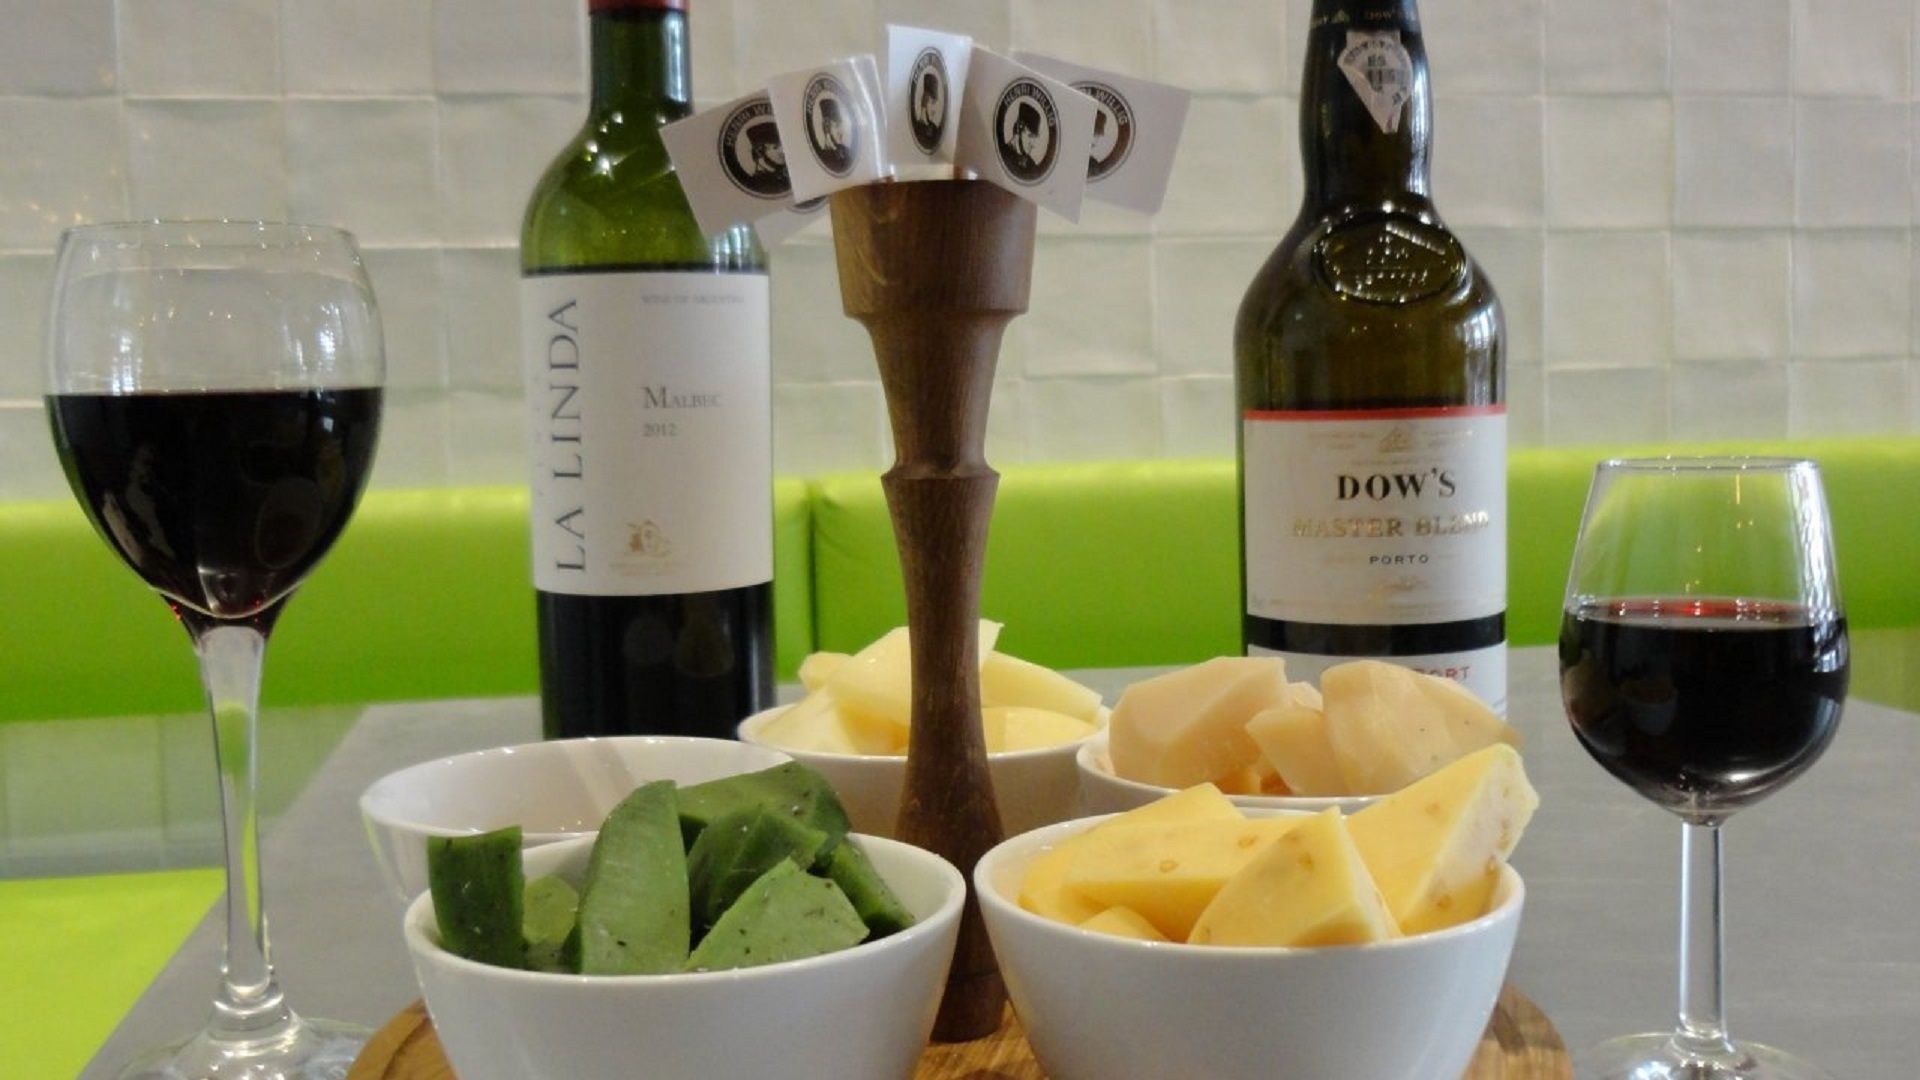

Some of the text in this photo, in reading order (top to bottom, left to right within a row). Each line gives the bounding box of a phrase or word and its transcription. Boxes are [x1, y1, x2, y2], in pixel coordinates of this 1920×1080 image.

[1004, 84, 1030, 106] HENRI
[1032, 86, 1056, 127] WILLIG
[1096, 87, 1128, 125] WILLIG
[725, 109, 752, 147] HENRI
[548, 299, 586, 572] LA LINDA
[643, 423, 678, 437] 2012
[1335, 467, 1457, 500] DOW'S
[1292, 517, 1404, 538] MASTER
[1368, 554, 1430, 565] PORTO
